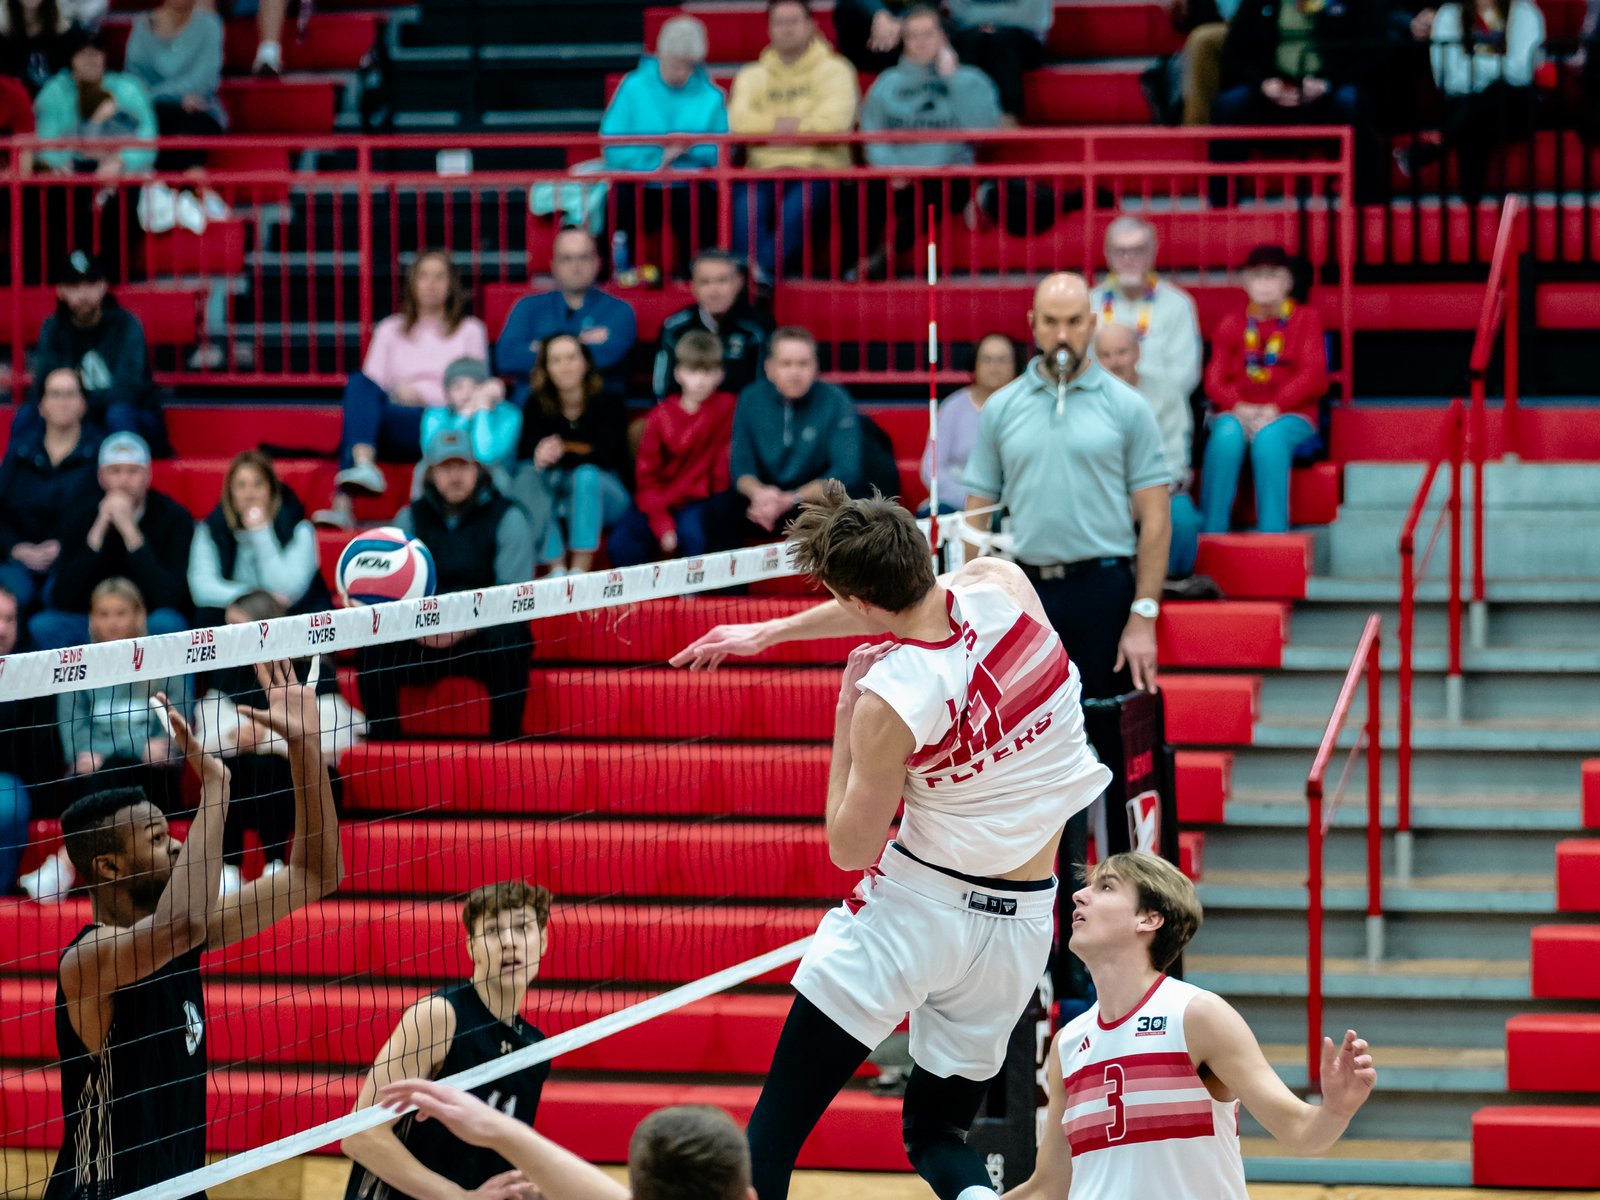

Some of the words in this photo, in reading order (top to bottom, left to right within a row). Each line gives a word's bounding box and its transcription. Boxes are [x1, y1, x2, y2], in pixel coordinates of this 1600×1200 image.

[355, 557, 391, 570] NCAA
[310, 613, 332, 628] LEWIS
[191, 629, 214, 645] LEWIS
[307, 628, 336, 645] FLYERS
[186, 645, 216, 663] FLYERS
[1137, 1016, 1164, 1032] 30
[1103, 1063, 1127, 1142] 3
